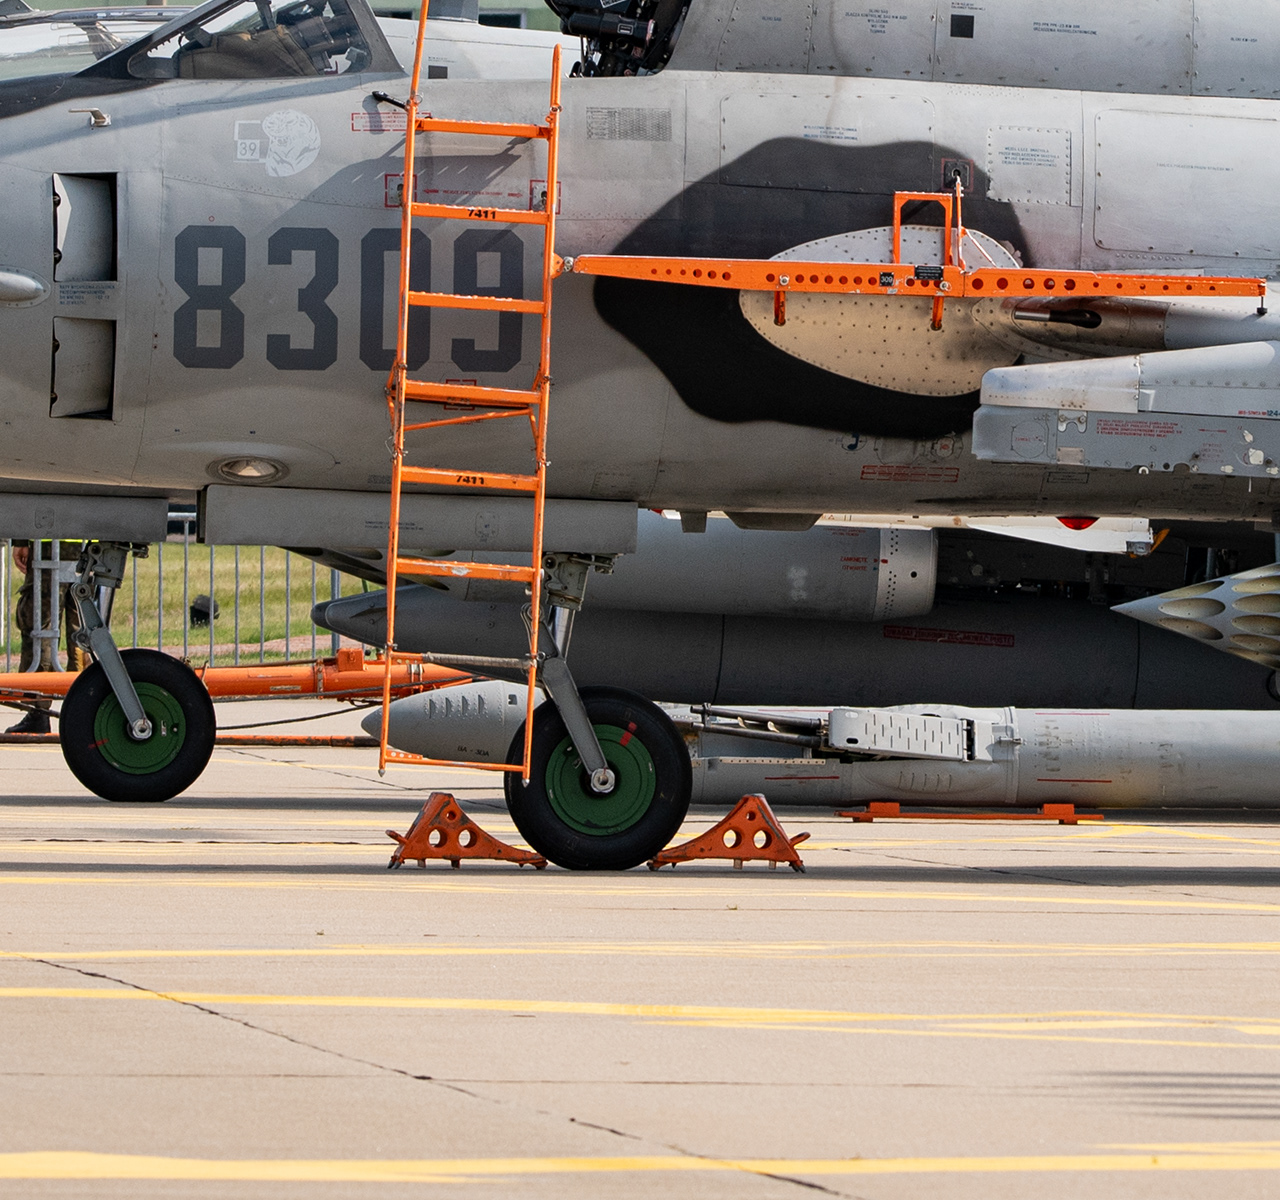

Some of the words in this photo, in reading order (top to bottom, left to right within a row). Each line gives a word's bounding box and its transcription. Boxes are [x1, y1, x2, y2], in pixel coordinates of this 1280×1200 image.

[239, 142, 257, 157] 39
[467, 208, 496, 219] 7411
[880, 275, 893, 283] 309
[172, 224, 526, 372] 8309
[456, 475, 485, 485] 7411
